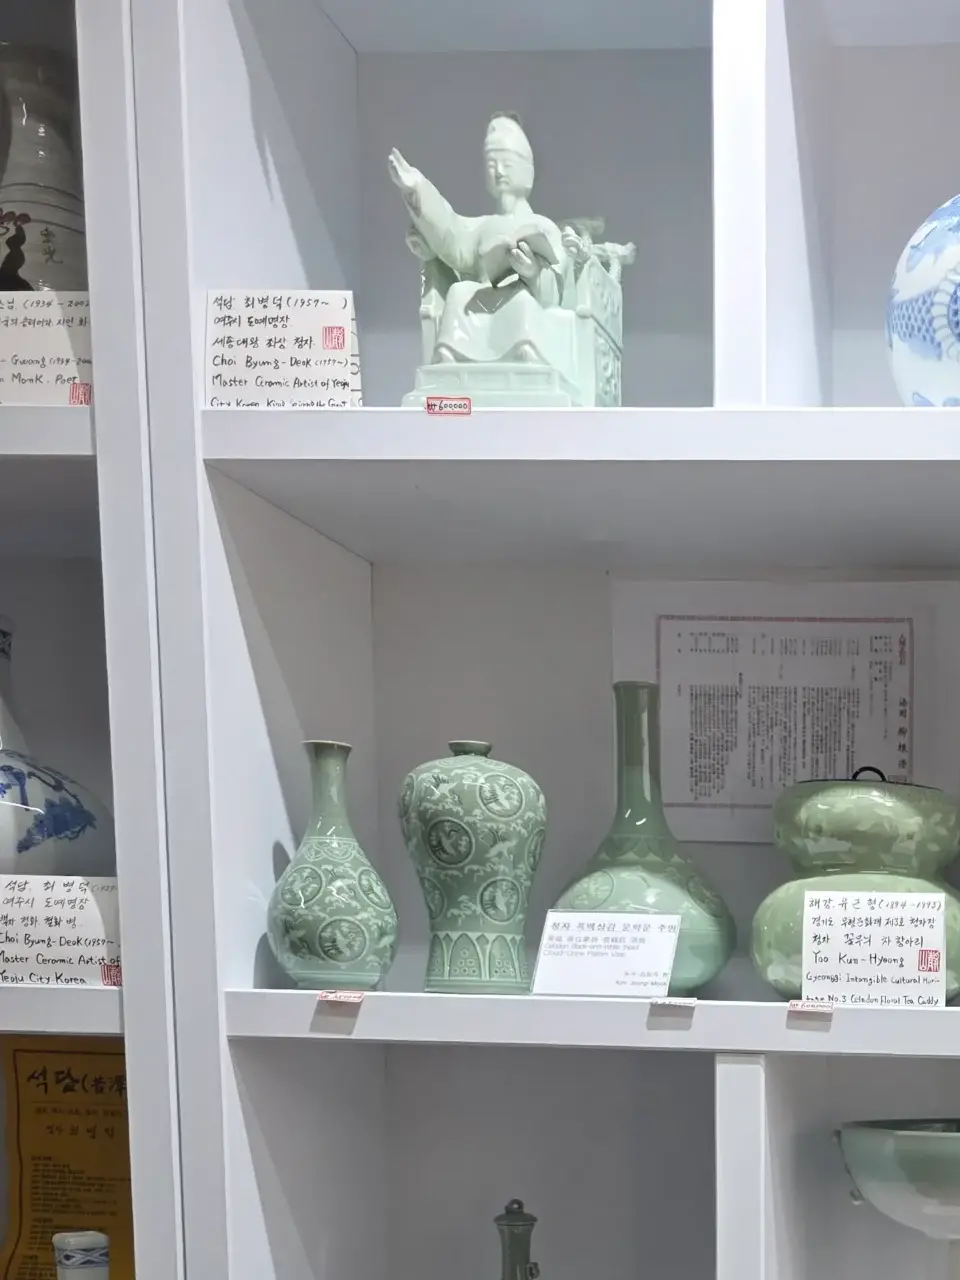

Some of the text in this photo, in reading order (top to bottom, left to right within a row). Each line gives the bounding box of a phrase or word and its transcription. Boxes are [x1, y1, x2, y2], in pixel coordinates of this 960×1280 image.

[212, 355, 236, 366] Choi
[212, 374, 248, 386] Master
[293, 377, 318, 388] Artist
[321, 378, 330, 390] of
[812, 916, 834, 927] 경기도
[812, 933, 830, 944] 청자
[36, 953, 106, 966] Ceramic Artist
[813, 950, 829, 963] Yoo
[29, 972, 50, 984] City
[846, 974, 887, 986] Intangible
[891, 975, 920, 984] Cultural
[903, 996, 914, 1004] Tea
